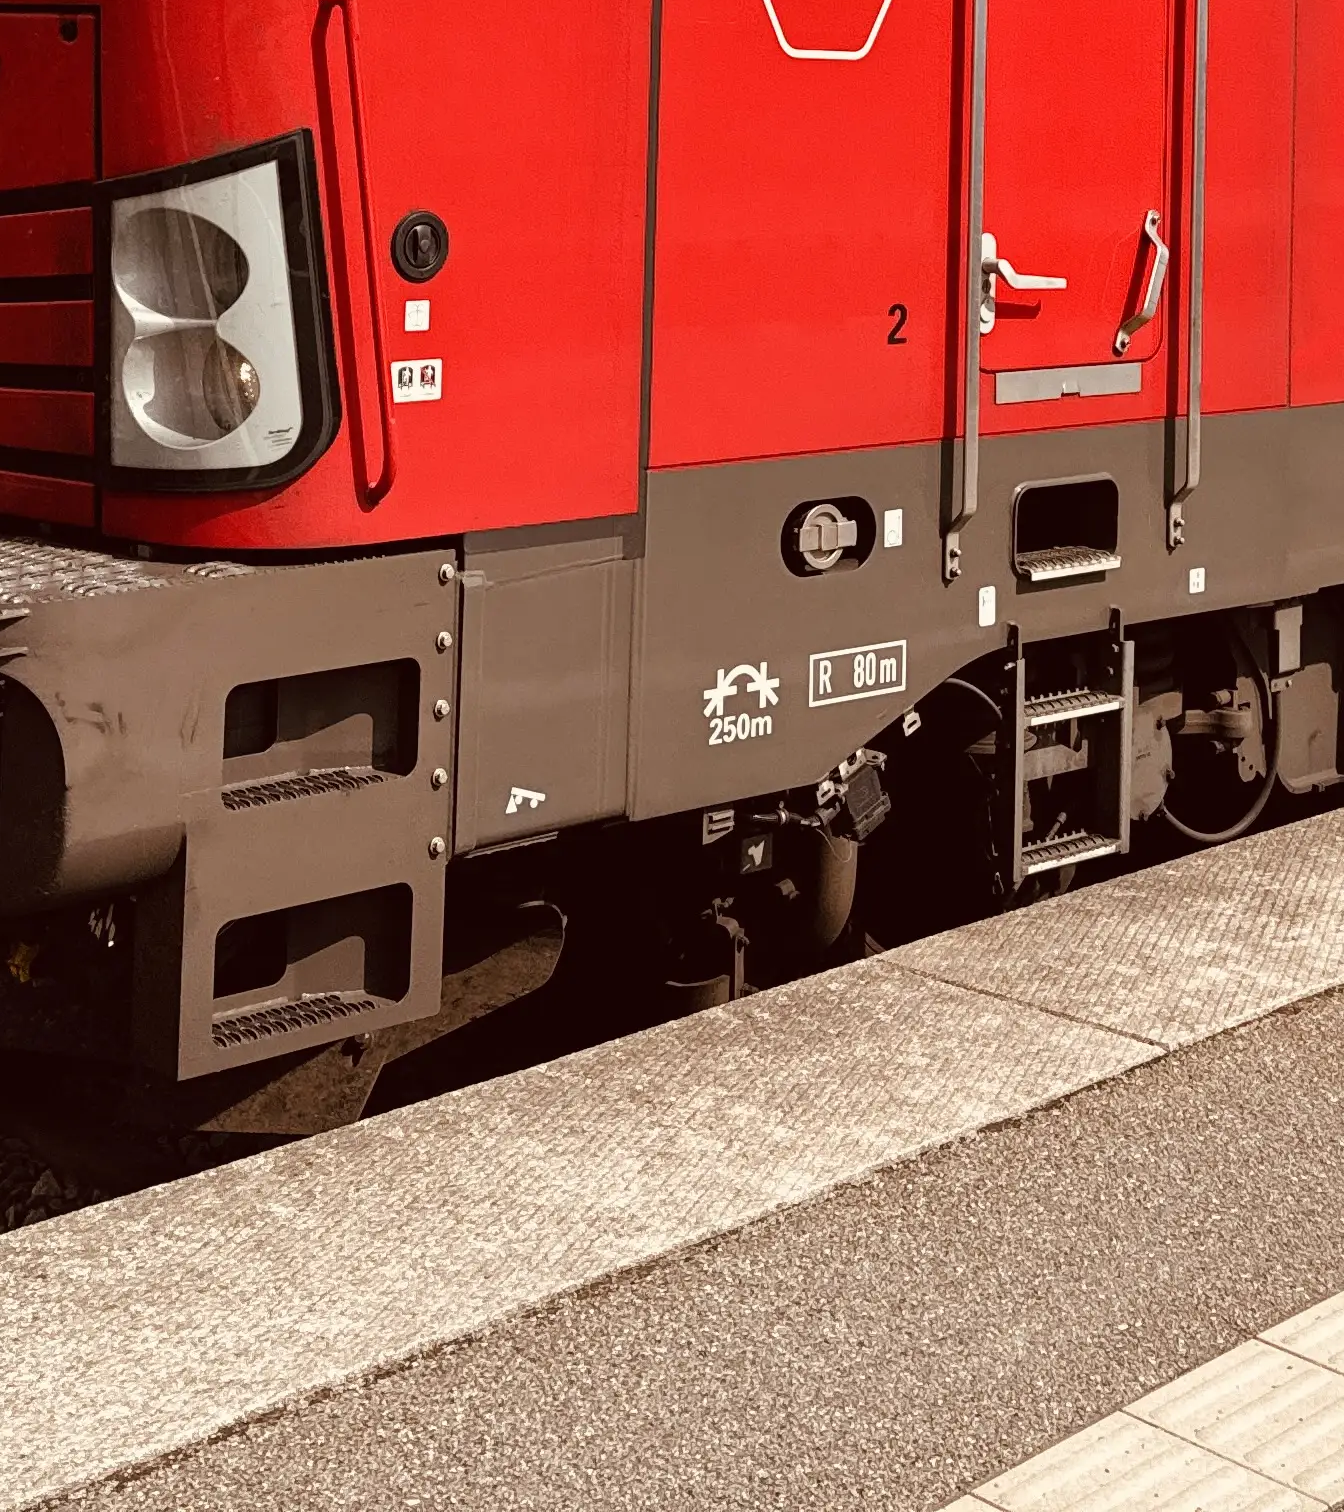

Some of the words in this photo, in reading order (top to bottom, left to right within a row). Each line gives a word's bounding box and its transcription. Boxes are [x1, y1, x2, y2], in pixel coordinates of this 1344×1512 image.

[887, 303, 908, 345] 2
[818, 659, 833, 695] R
[708, 713, 773, 746] 250m
